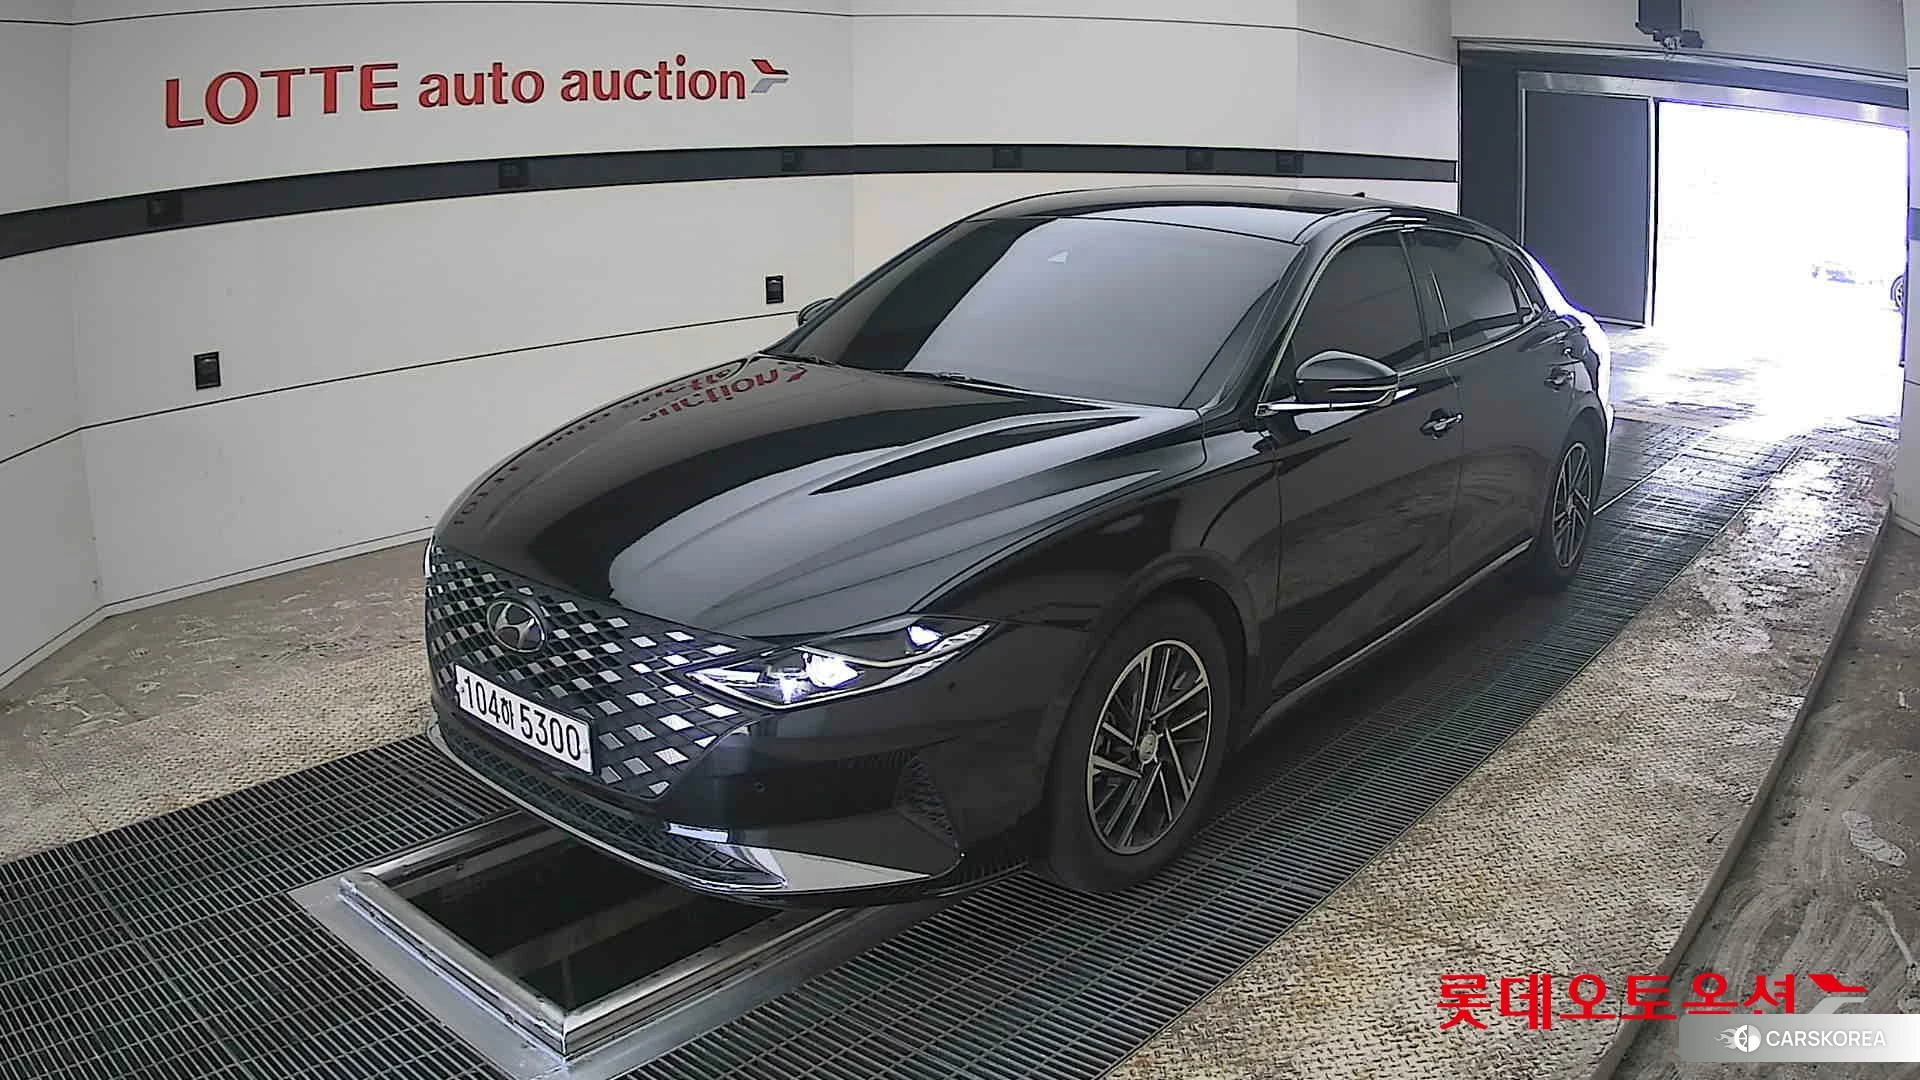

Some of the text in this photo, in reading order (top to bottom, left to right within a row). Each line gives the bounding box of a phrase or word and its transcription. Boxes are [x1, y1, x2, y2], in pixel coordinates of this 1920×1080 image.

[164, 54, 747, 129] LOTTE auto auction
[519, 703, 582, 761] 5300
